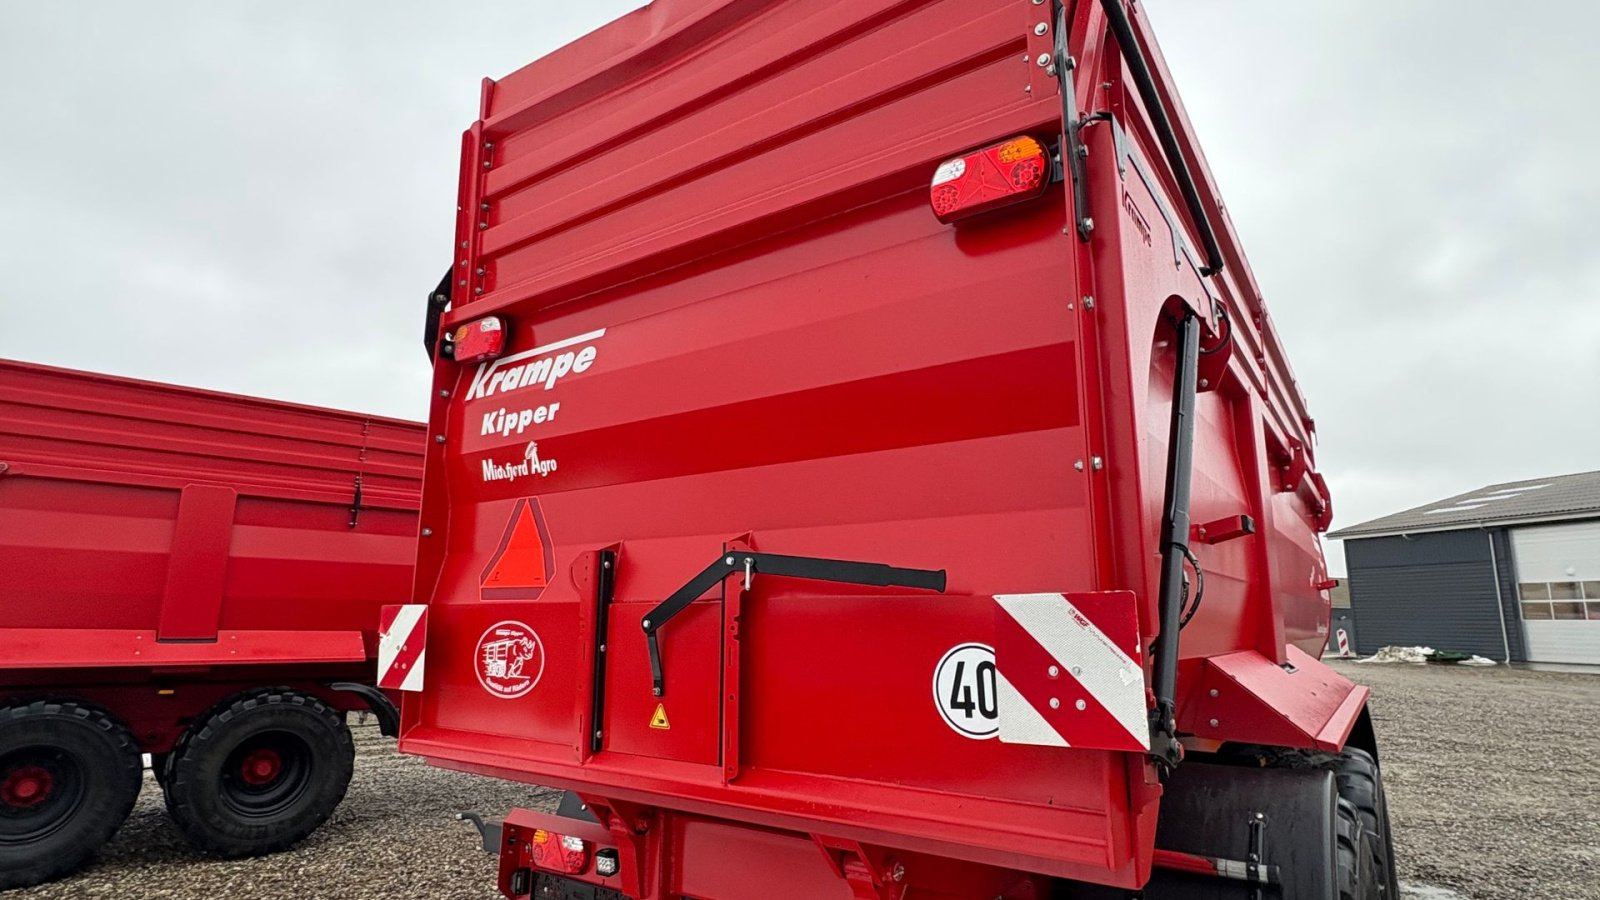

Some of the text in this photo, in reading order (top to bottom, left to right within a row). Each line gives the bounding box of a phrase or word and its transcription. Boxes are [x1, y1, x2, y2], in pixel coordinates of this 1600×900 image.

[465, 328, 606, 401] Krampe
[480, 402, 560, 437] Kipper
[530, 445, 558, 477] Agro
[950, 660, 999, 720] 40
